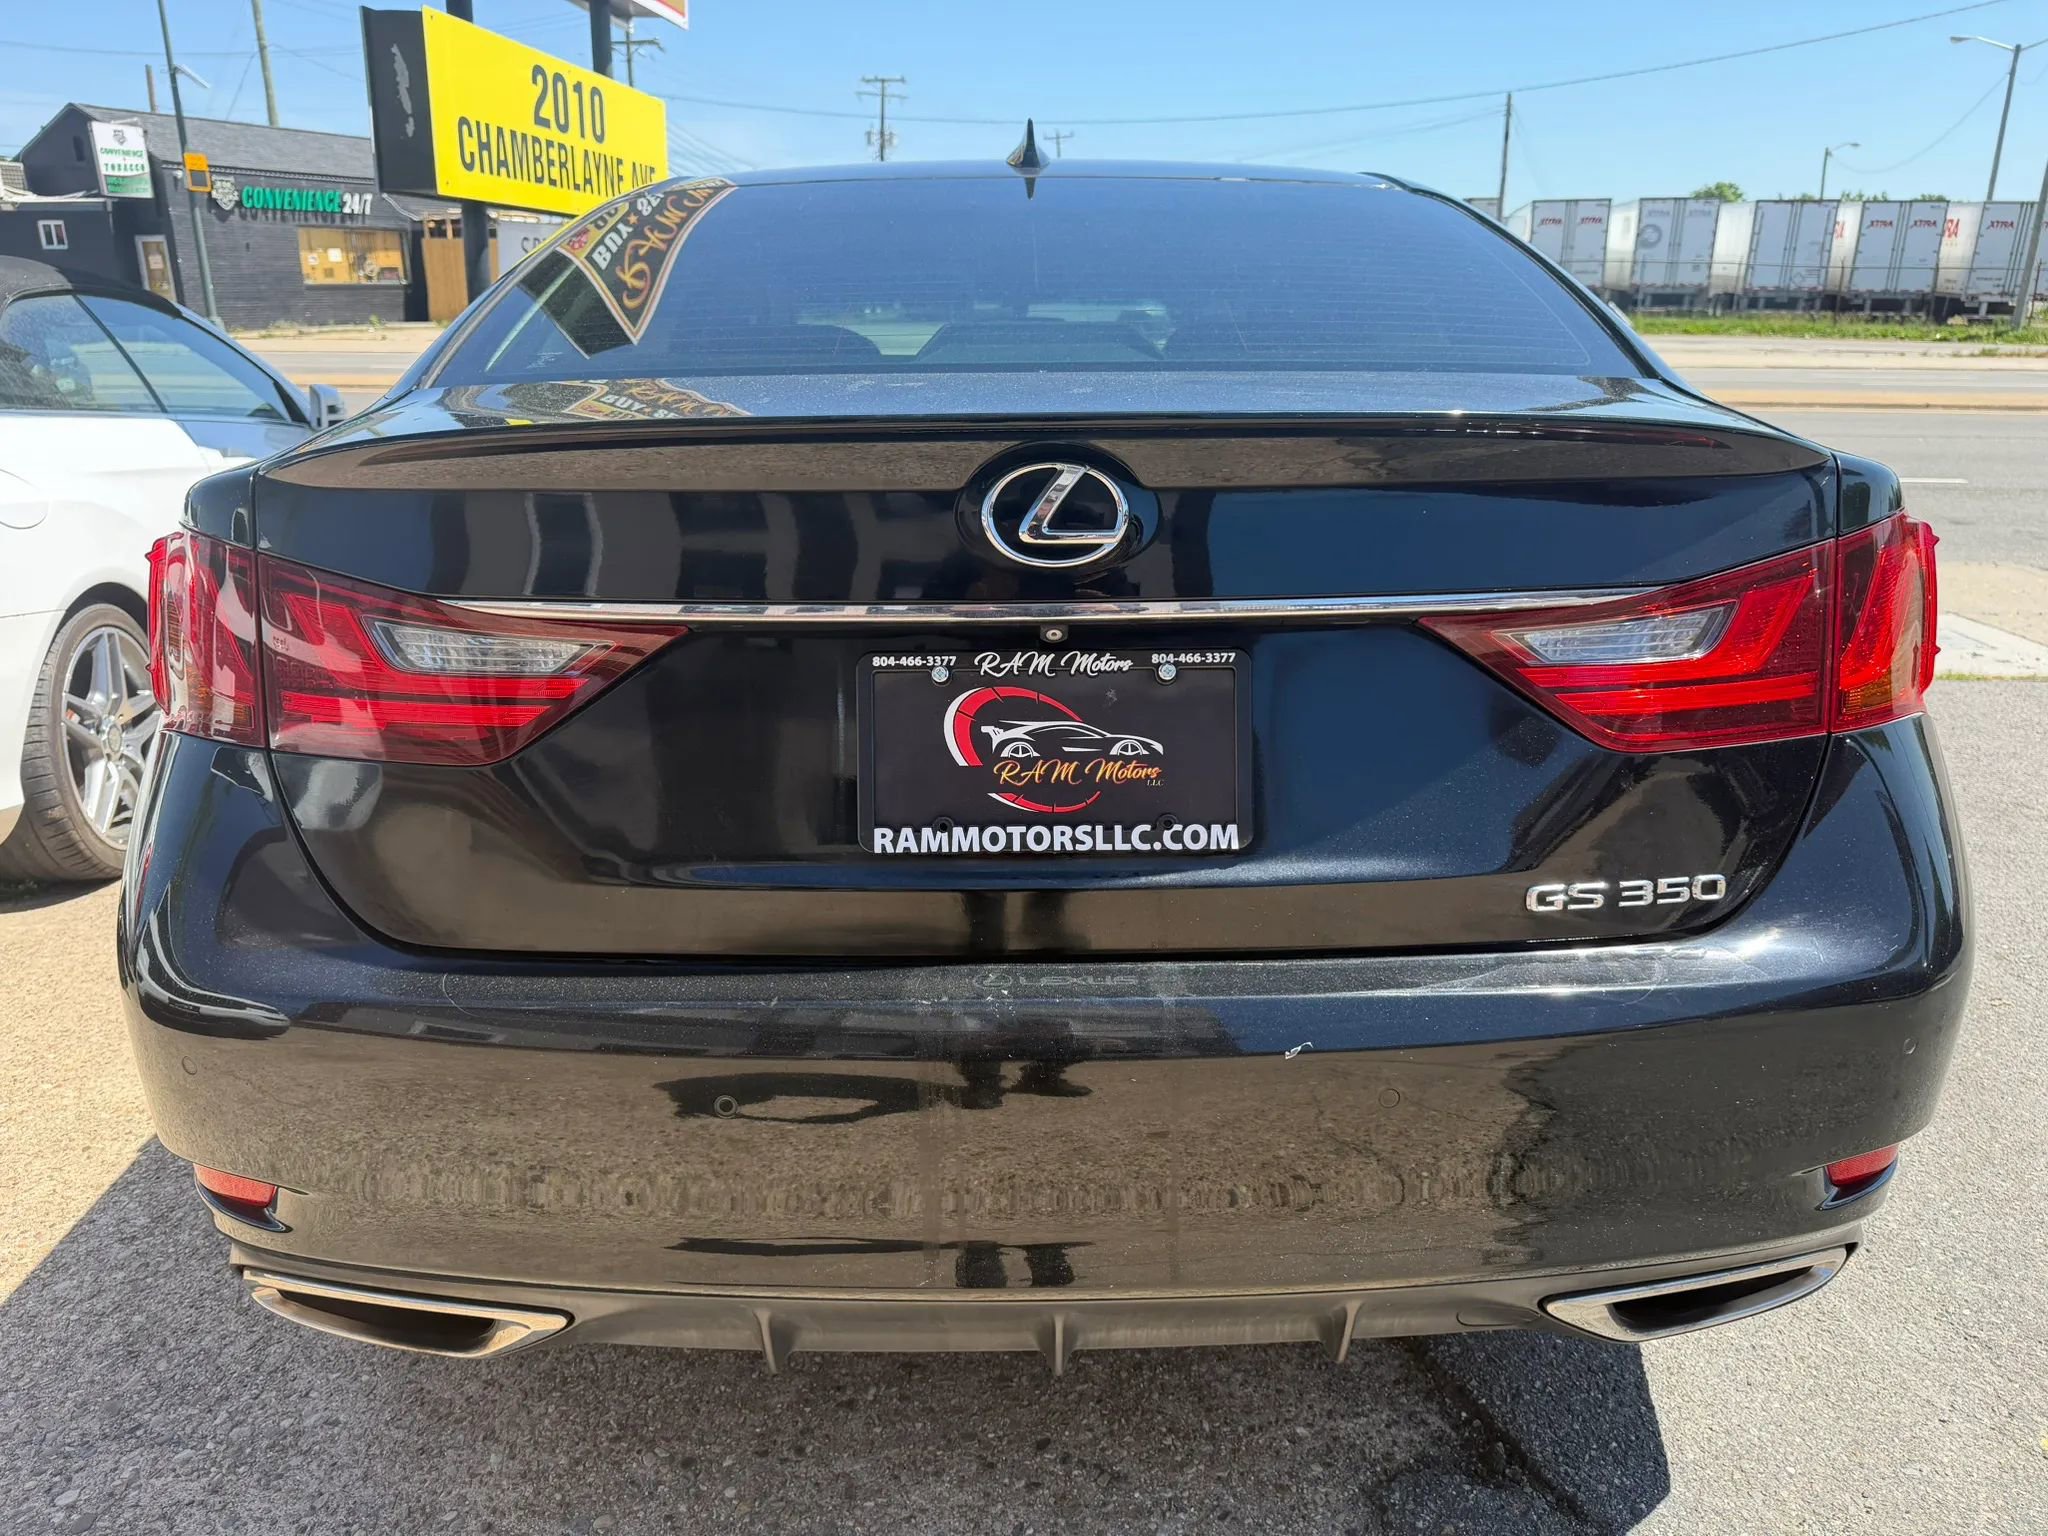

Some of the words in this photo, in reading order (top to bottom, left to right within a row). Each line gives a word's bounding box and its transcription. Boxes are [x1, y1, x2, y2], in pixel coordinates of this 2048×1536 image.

[531, 64, 606, 144] 2010
[457, 116, 624, 196] CHAMBERLAYNE
[104, 163, 145, 172] TOBACCO
[1866, 219, 1893, 230] XTRA
[1910, 219, 1937, 229] XTRA
[1986, 220, 2014, 230] XTRA
[872, 656, 957, 667] 804-466-3377
[974, 650, 1056, 677] RAM
[1060, 651, 1134, 676] Motors
[1151, 652, 1236, 664] 804-466-3377
[993, 758, 1082, 786] RAM
[1084, 758, 1164, 782] Motors
[873, 823, 1239, 854] RAMMOTORSLLC.COM
[1526, 882, 1607, 913] GS
[1618, 873, 1726, 907] 350
[1019, 975, 1137, 985] LEXUS
